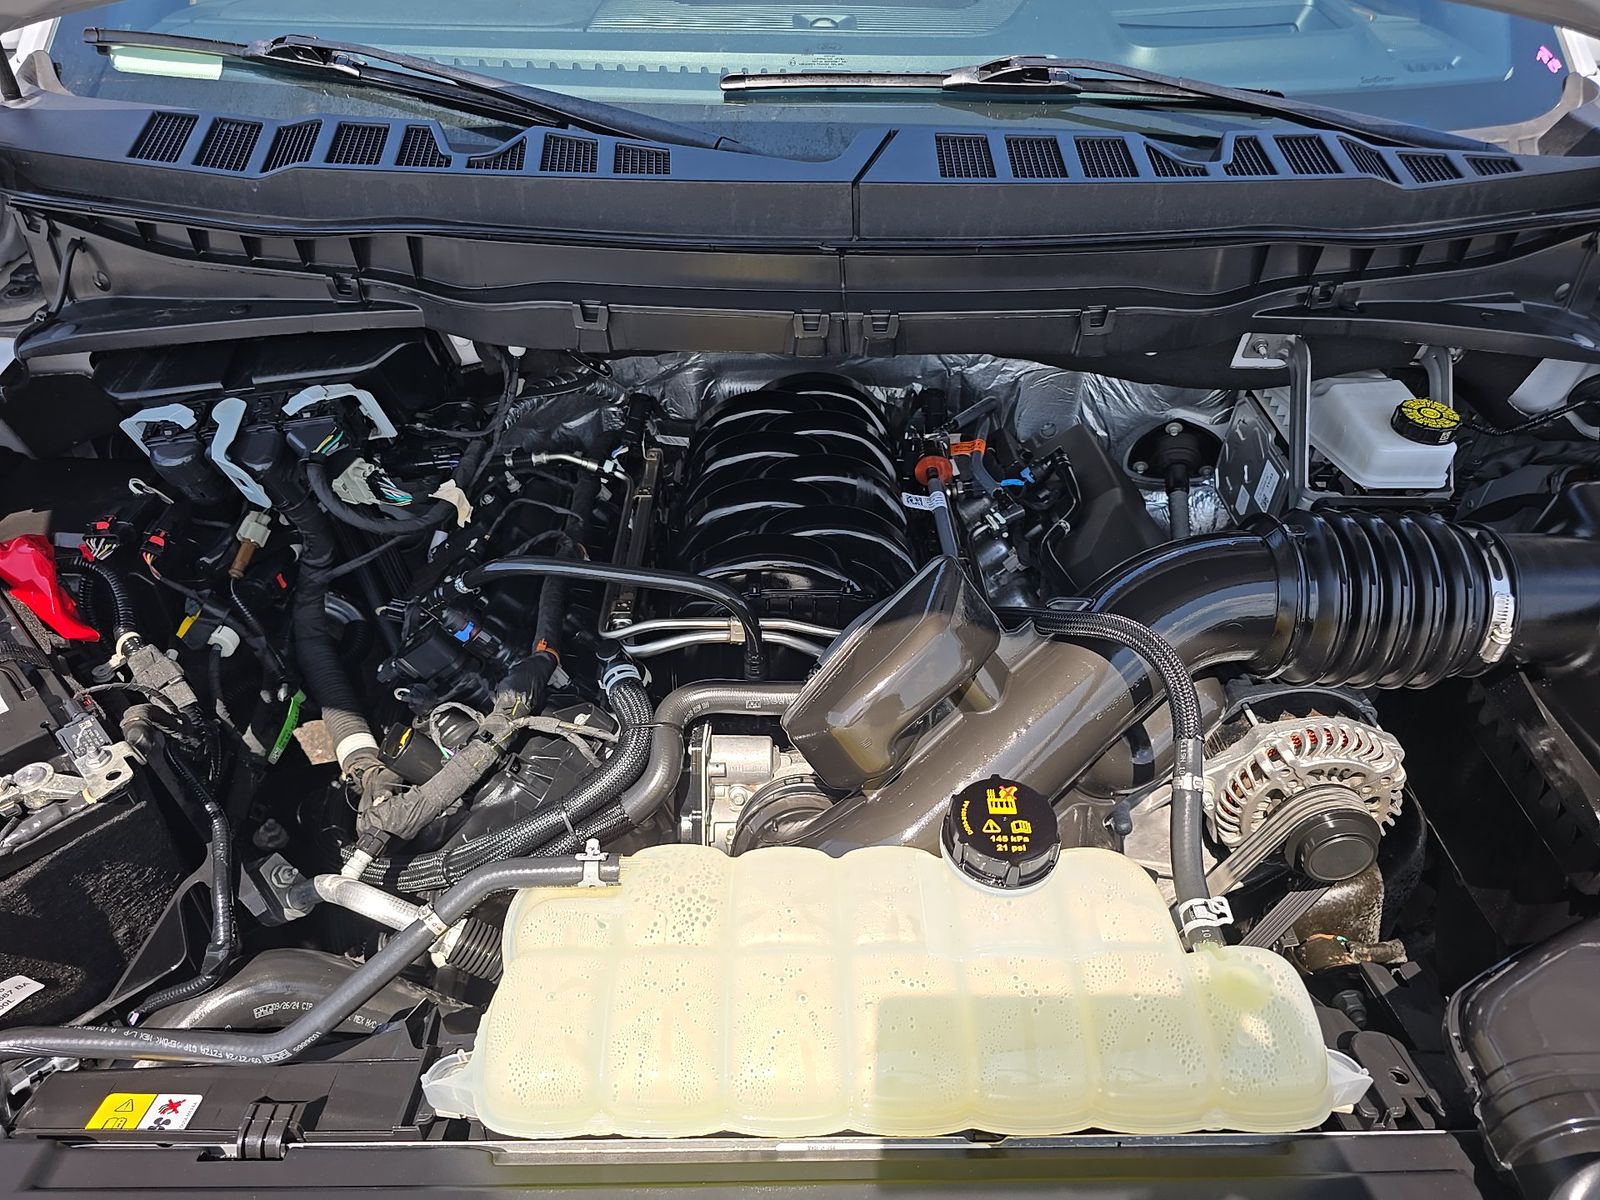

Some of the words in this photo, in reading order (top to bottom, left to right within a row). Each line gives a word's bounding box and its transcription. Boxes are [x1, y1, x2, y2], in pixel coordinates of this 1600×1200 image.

[1011, 835, 1030, 843] kPa
[996, 844, 1008, 852] 21
[1011, 844, 1027, 853] psi
